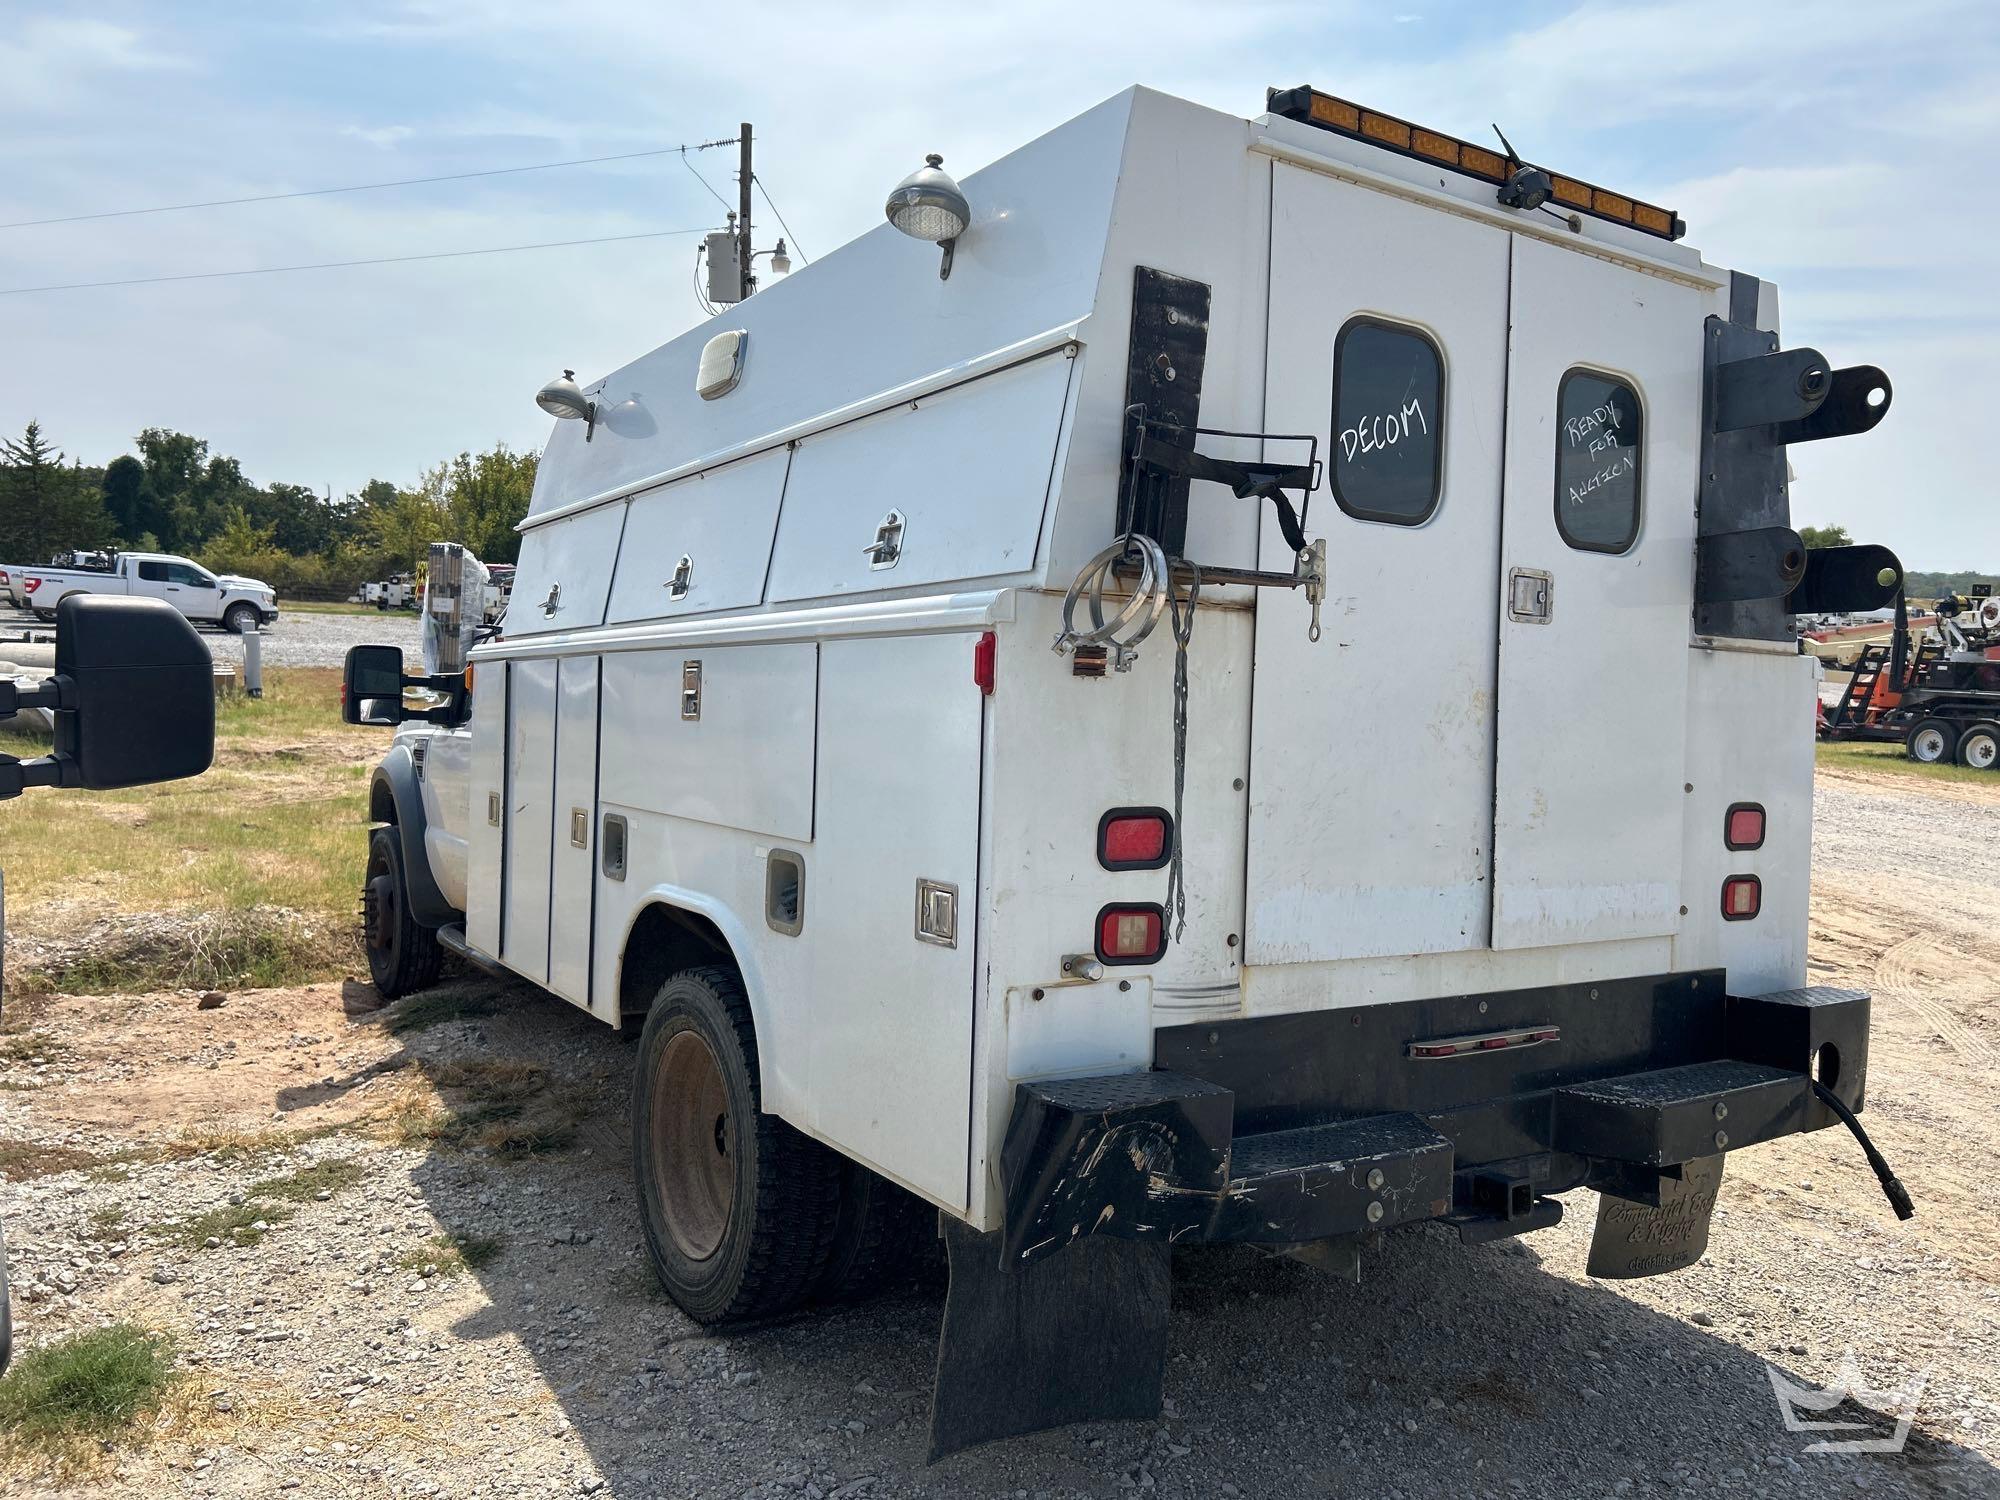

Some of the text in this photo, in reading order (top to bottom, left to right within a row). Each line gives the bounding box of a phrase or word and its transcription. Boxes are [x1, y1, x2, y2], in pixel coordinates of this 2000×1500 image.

[1339, 398, 1427, 463] DECOM
[1563, 400, 1620, 448] READY
[1588, 429, 1618, 463] FOR
[1569, 449, 1633, 506] AUCTION
[1626, 1222, 1644, 1244] &
